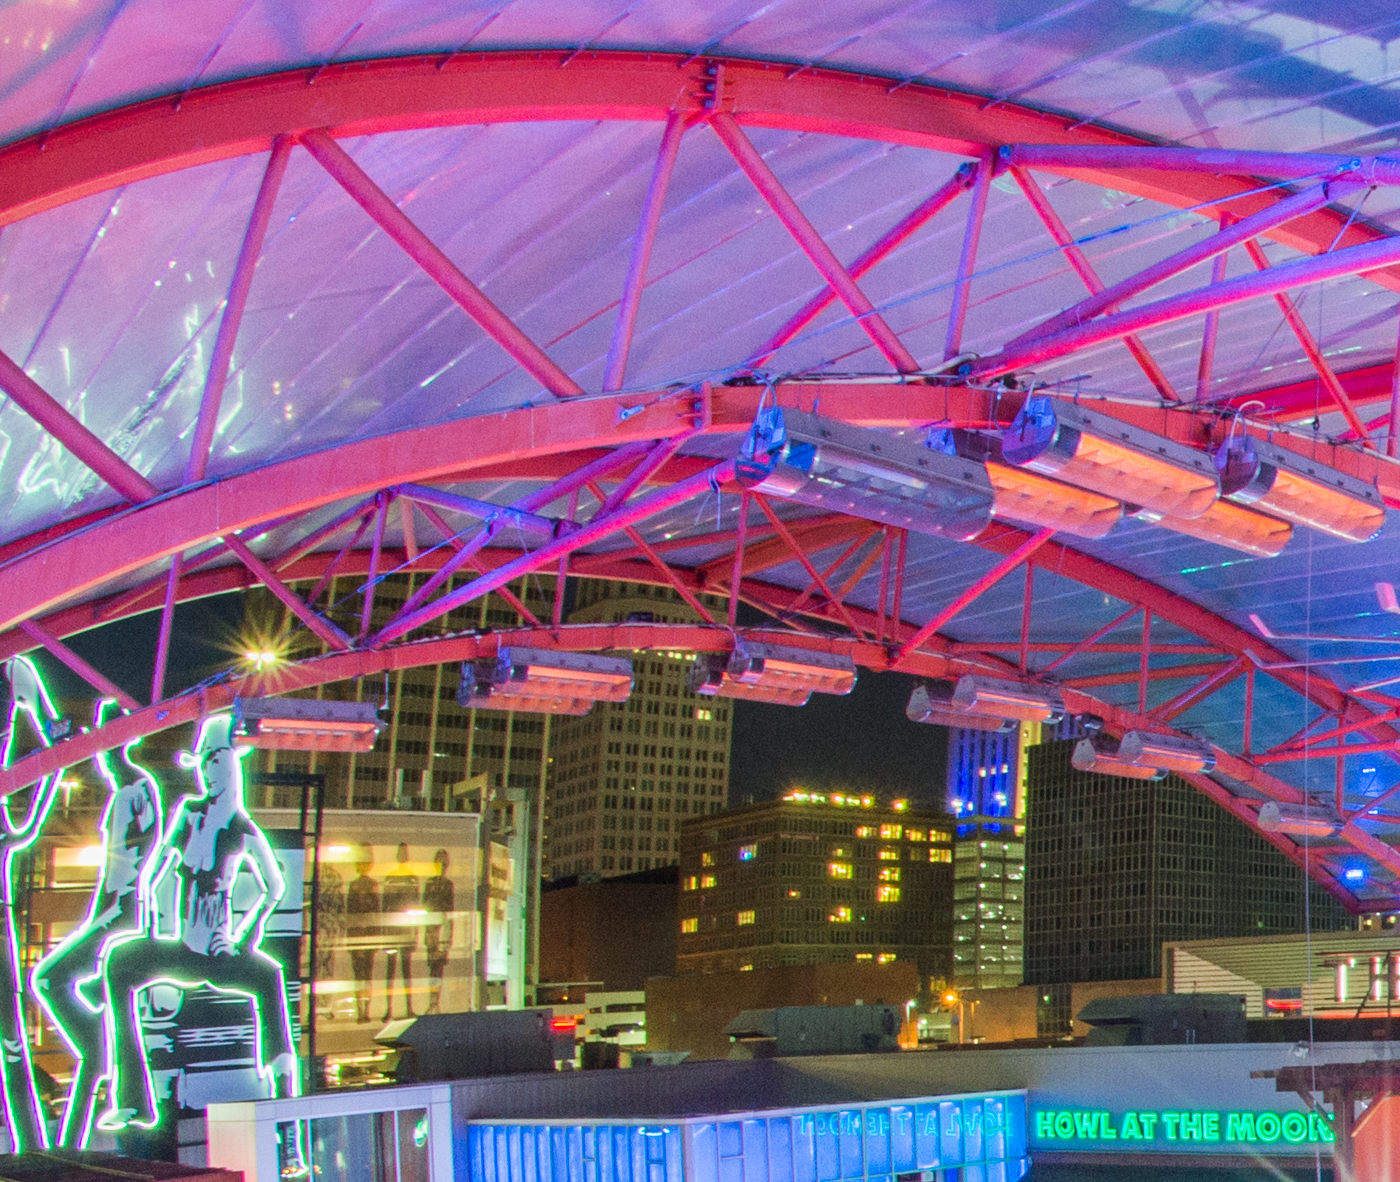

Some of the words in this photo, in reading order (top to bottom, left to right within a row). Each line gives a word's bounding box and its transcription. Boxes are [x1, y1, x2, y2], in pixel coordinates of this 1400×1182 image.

[1036, 1111, 1117, 1140] HOWL
[1120, 1112, 1157, 1140] AT
[1162, 1112, 1219, 1141] THE
[1226, 1112, 1336, 1143] MOON
